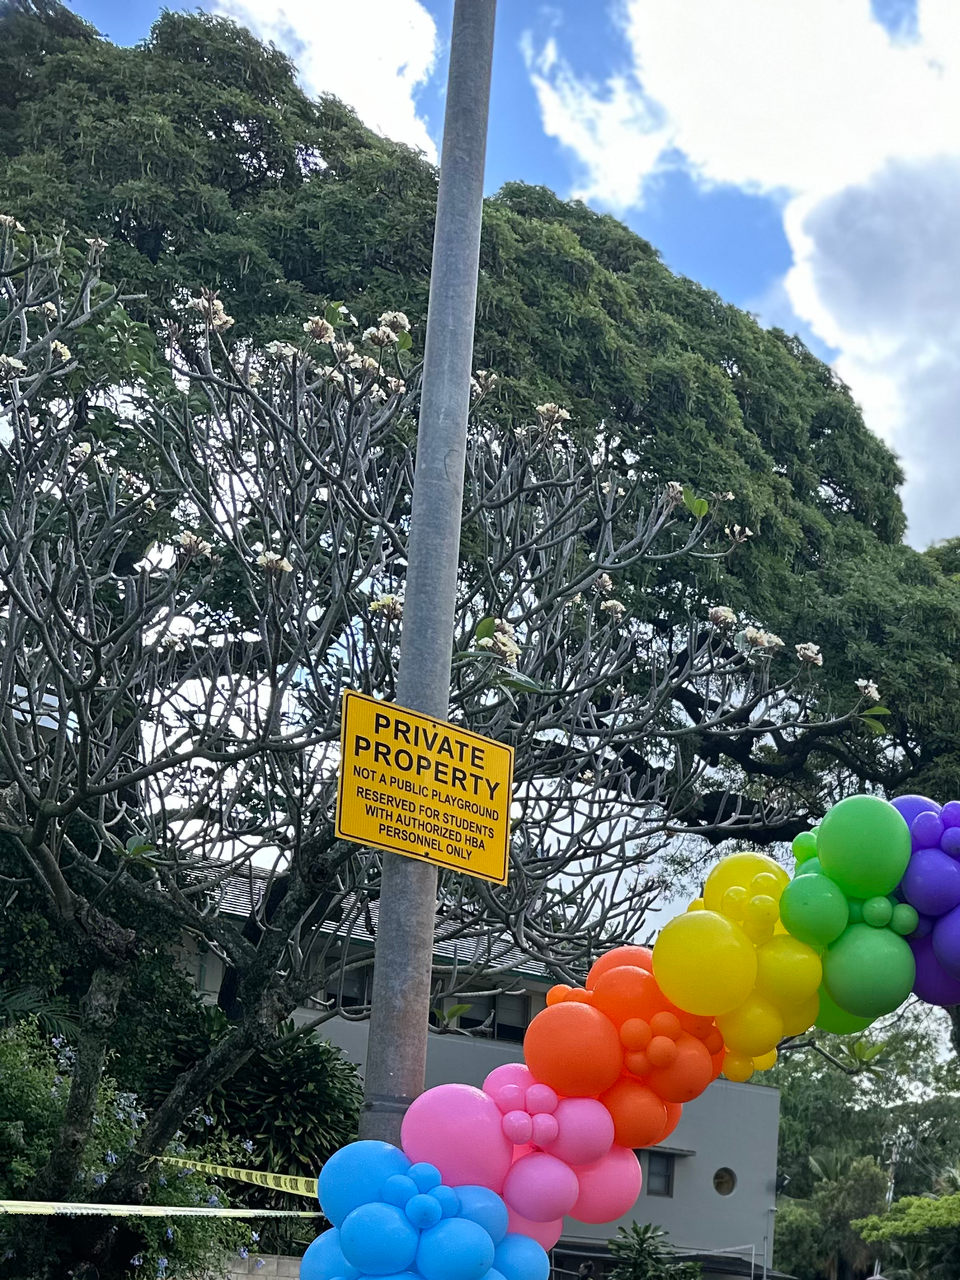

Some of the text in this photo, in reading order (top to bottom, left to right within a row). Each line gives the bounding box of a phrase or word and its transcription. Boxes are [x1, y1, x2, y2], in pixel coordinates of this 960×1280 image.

[354, 735, 500, 801] PROPERTY
[375, 713, 485, 770] PRIVATE
[353, 765, 499, 821] NOT A PUBLIC PLAYGROUND
[356, 786, 494, 839] RESERVED FOR STUDENTS
[365, 804, 485, 851] WITH AUTHORIZED HBA
[379, 823, 472, 860] PERSONNEL ONLY
